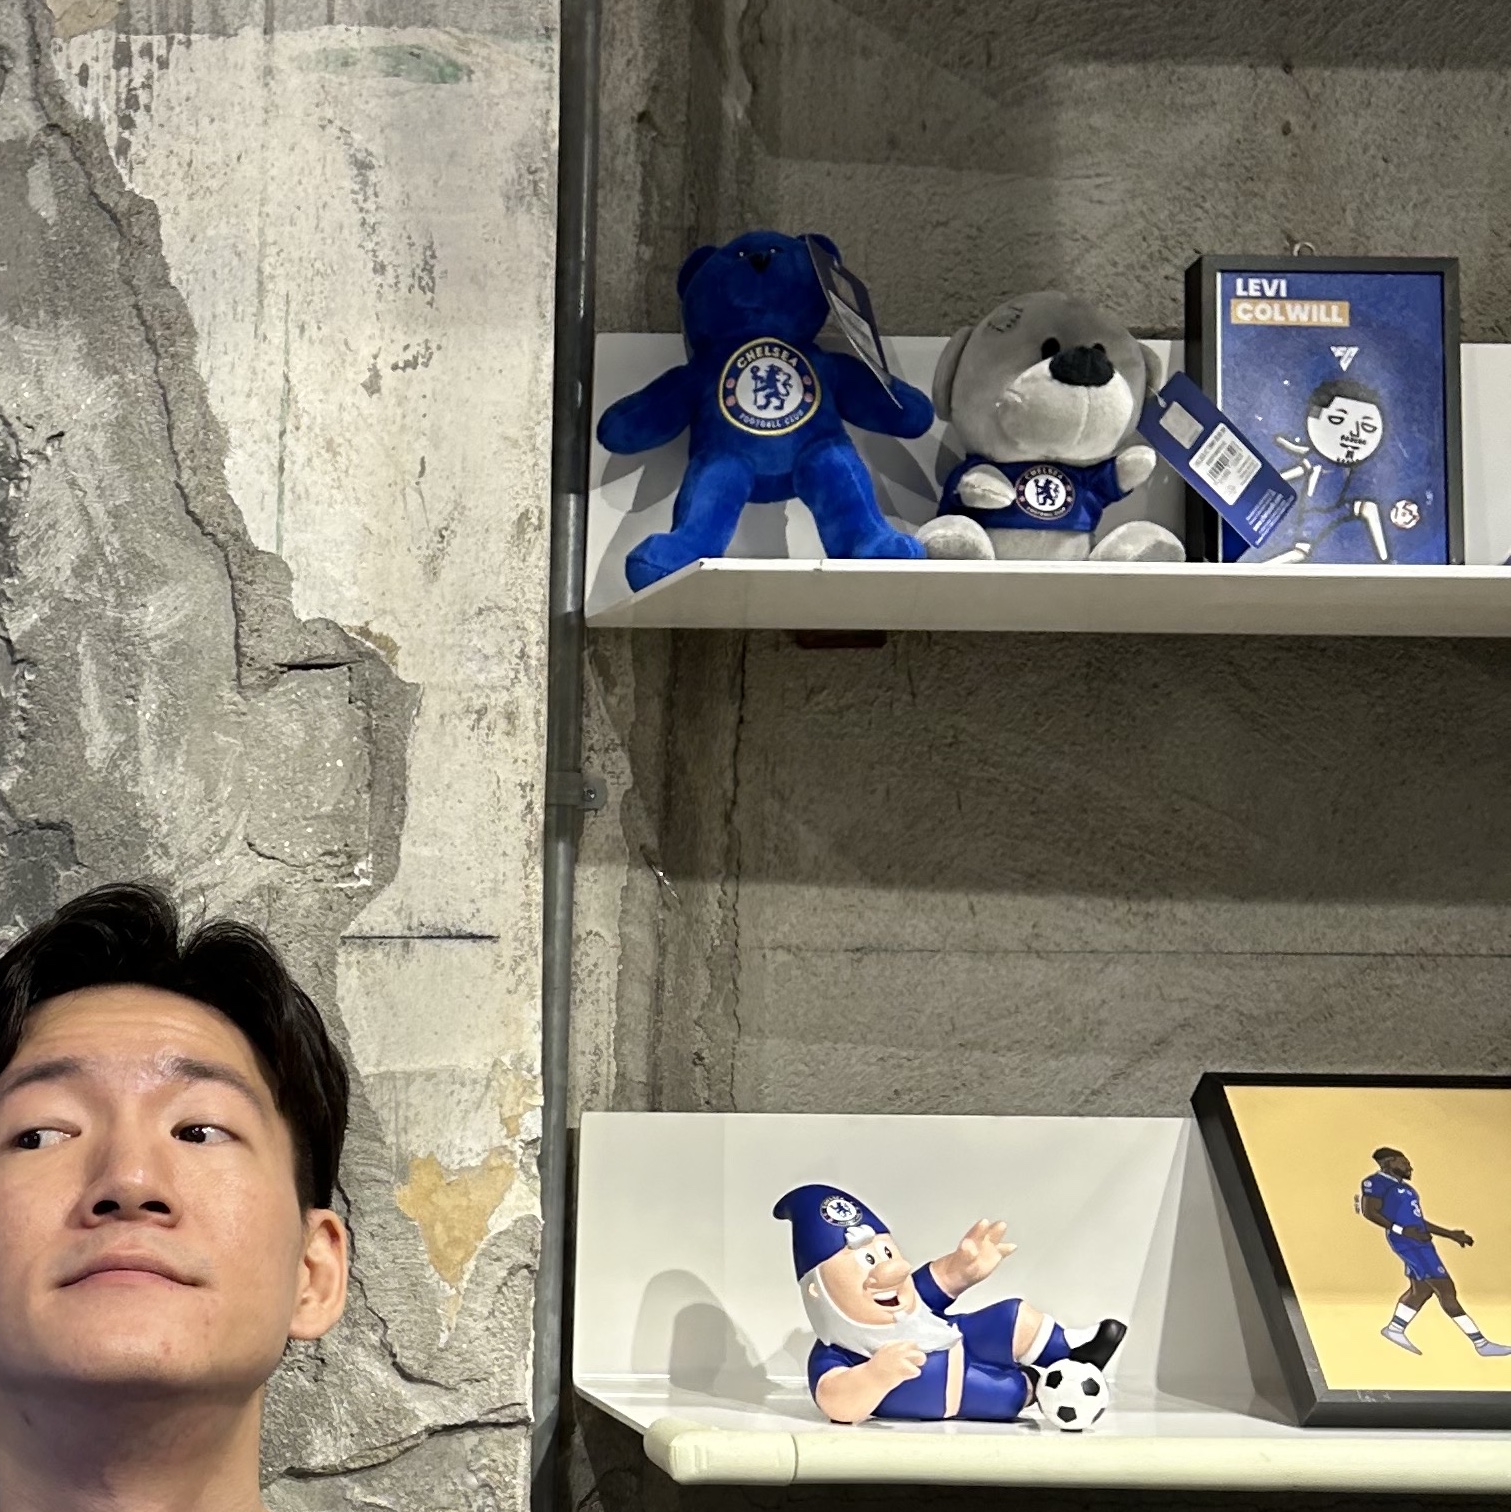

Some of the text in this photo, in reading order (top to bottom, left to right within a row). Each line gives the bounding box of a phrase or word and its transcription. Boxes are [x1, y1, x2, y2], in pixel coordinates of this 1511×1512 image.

[1236, 278, 1287, 298] LEVI
[1237, 302, 1343, 323] COLWILL
[737, 346, 798, 368] CHELSEA
